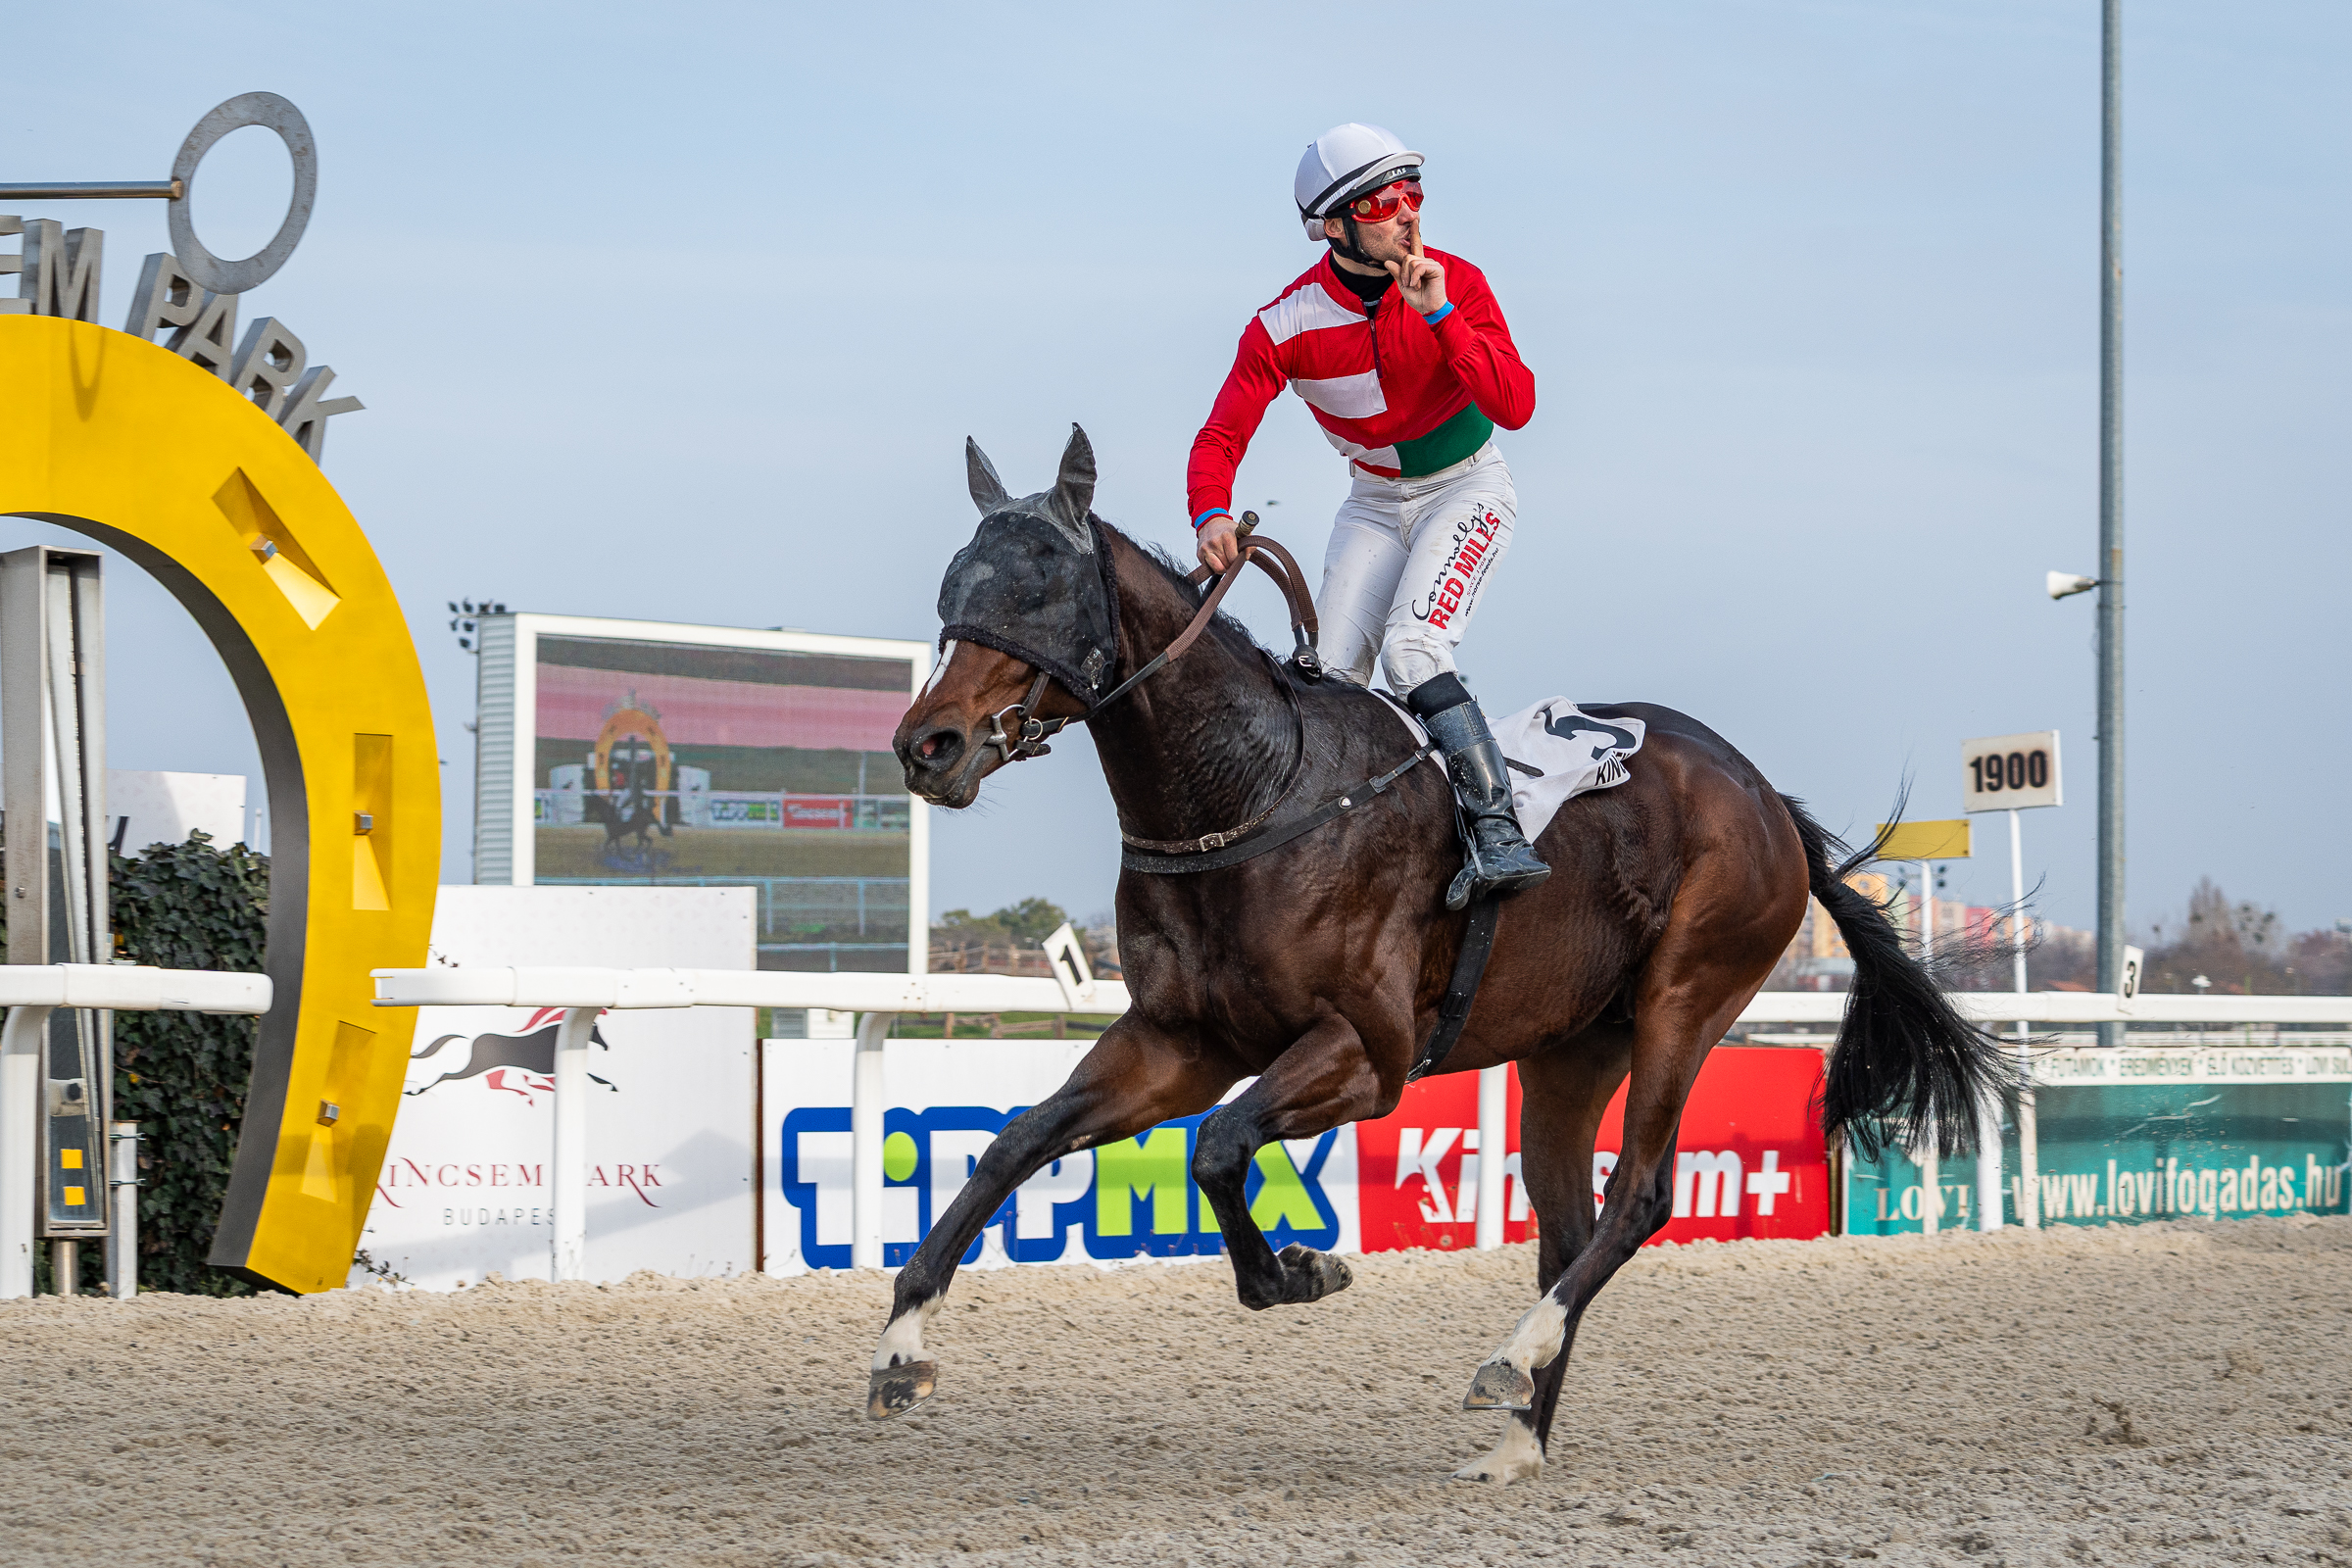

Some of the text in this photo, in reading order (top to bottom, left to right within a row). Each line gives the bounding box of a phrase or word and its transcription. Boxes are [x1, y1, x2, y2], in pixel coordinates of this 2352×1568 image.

[124, 252, 368, 467] PARK
[1412, 503, 1489, 620] Connolly's
[1428, 512, 1501, 630] RED MILLS
[1968, 750, 2049, 793] 1900
[1059, 944, 1083, 986] 1
[2123, 959, 2137, 999] 3
[377, 1156, 662, 1207] INCSEM ARK
[1395, 1127, 1790, 1223] Kinsm+
[443, 1207, 555, 1226] BUDAPES
